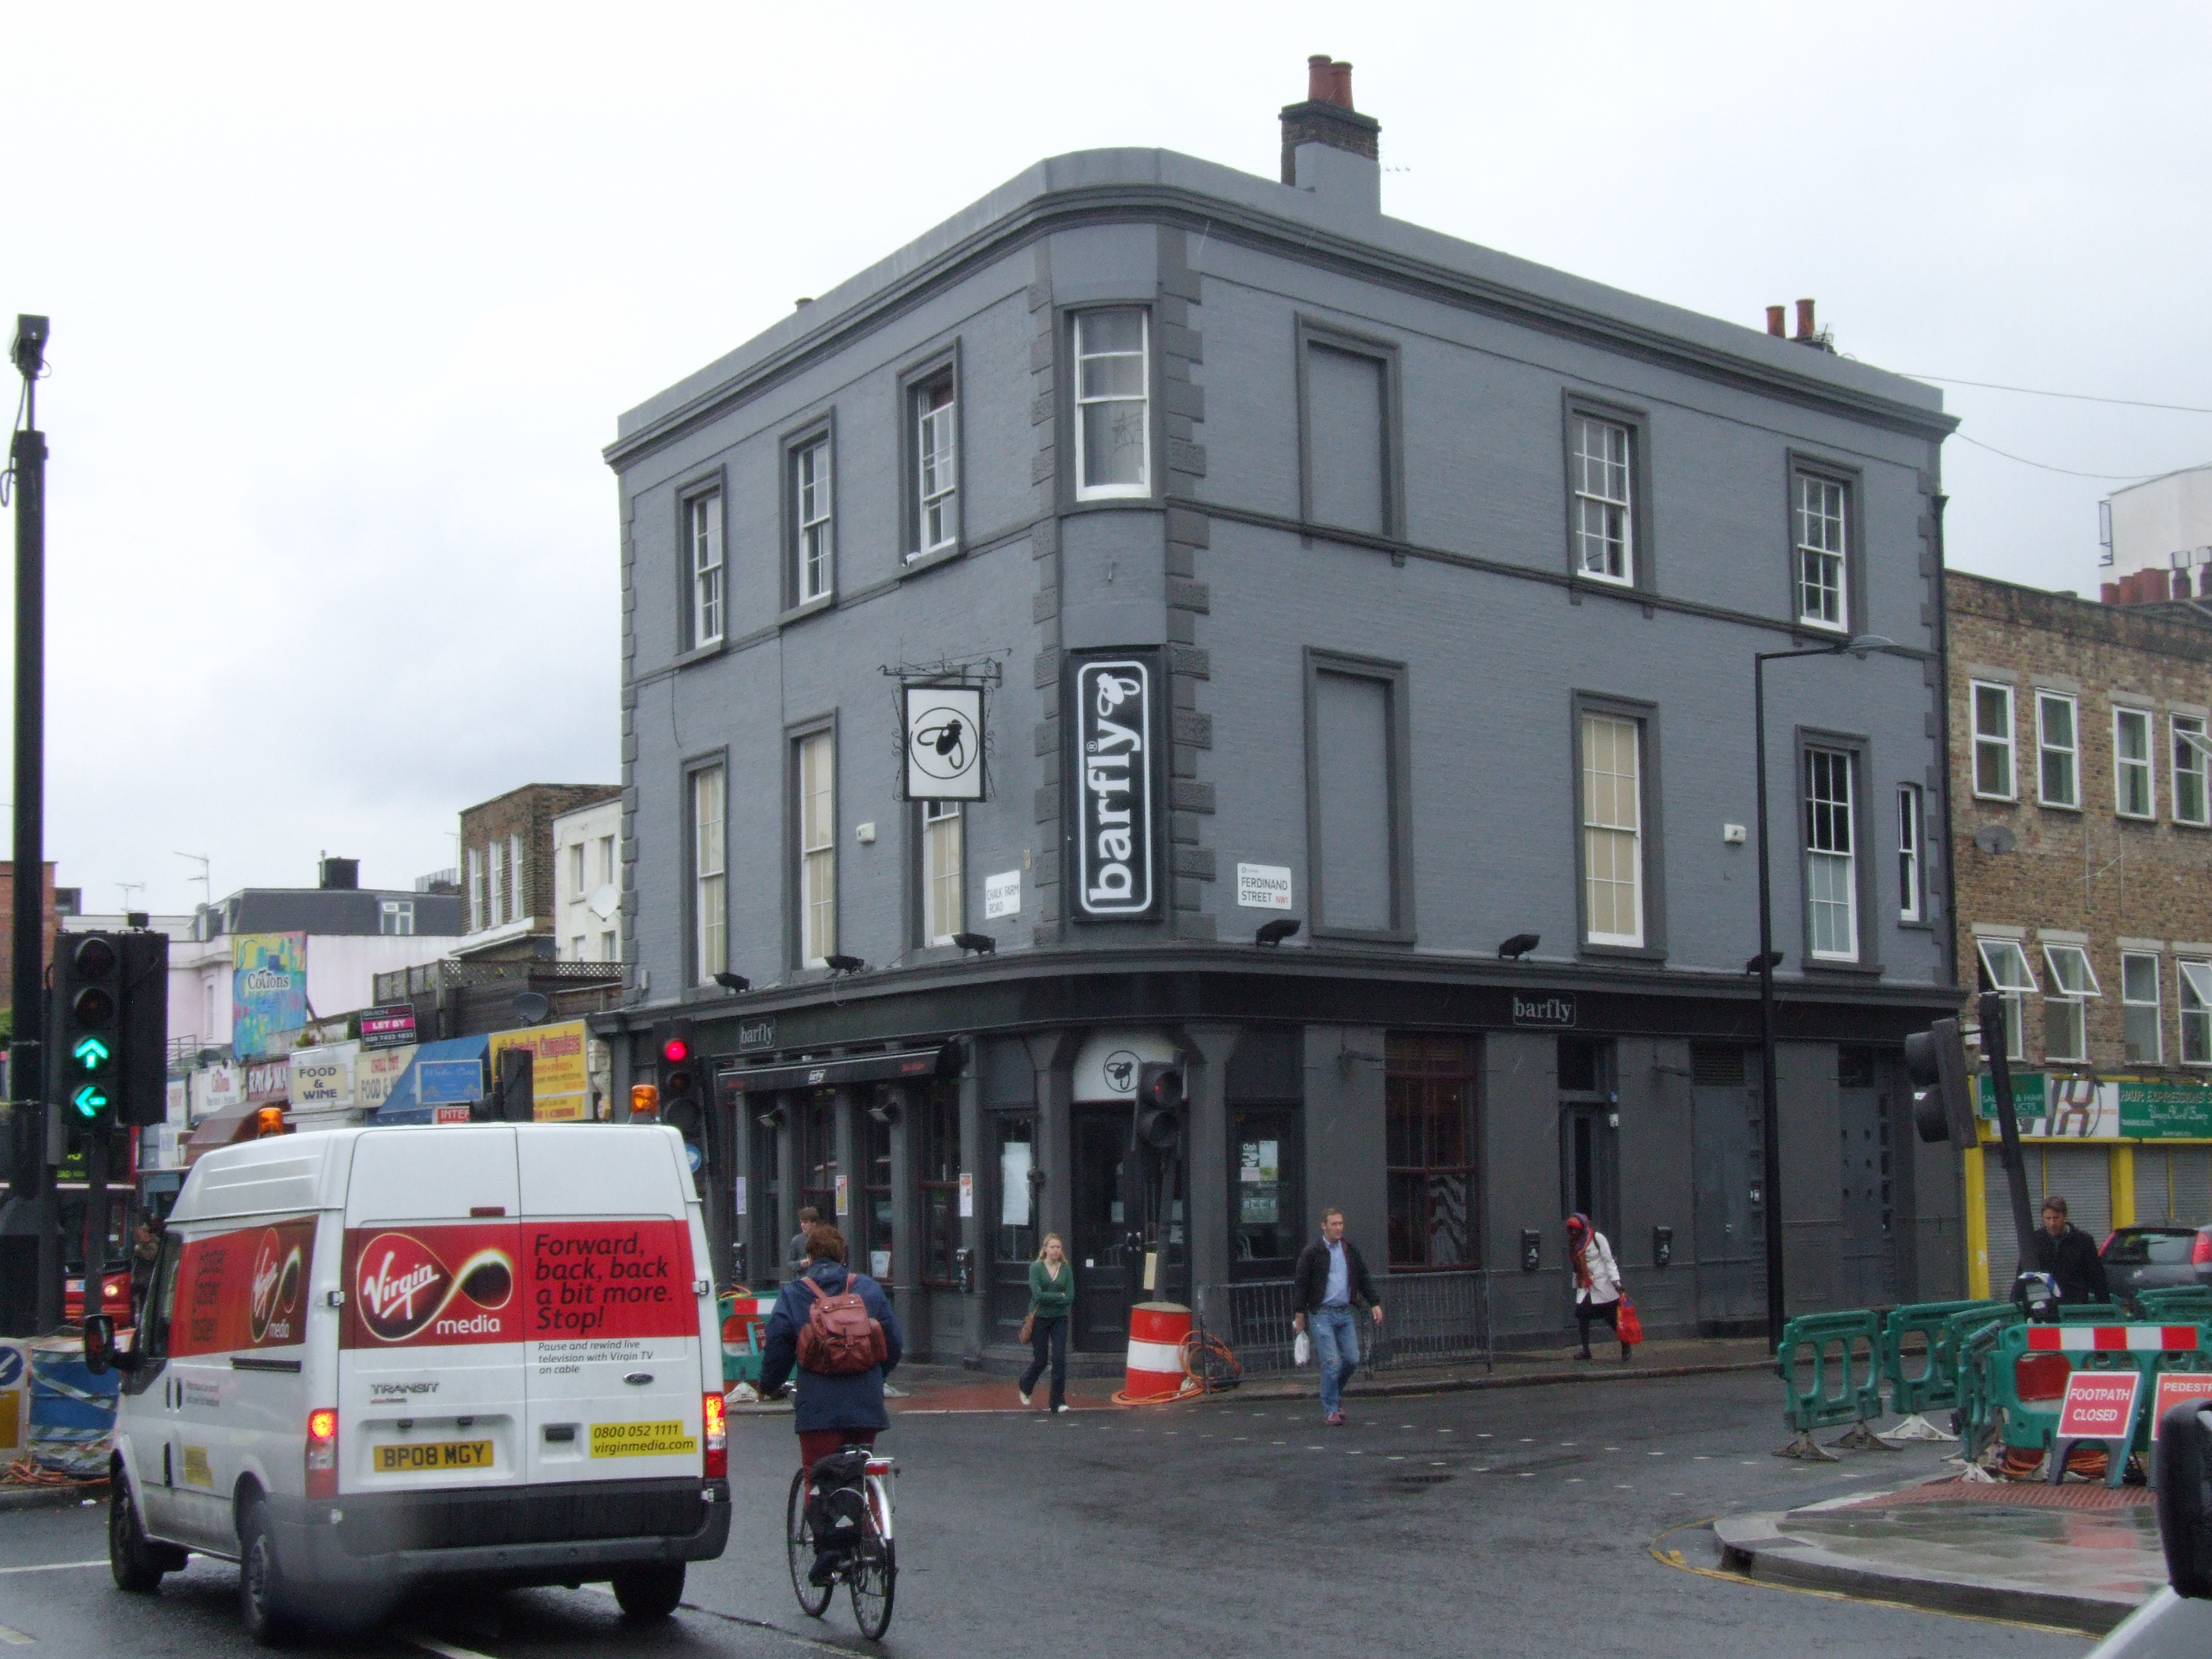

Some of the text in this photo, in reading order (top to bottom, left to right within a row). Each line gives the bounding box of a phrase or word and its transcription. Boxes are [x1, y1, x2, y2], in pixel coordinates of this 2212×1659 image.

[1241, 877, 1287, 890] FERDINAND
[987, 883, 1019, 900] CHALK FARM
[1242, 891, 1288, 904] STREET NW1
[989, 901, 1003, 913] ROAD
[248, 968, 290, 989] Cottons
[1513, 997, 1571, 1022] barfly
[372, 1018, 405, 1029] LET BY
[740, 1023, 773, 1044] barfly
[299, 1066, 337, 1077] FOOD
[314, 1079, 324, 1088] &
[361, 1078, 381, 1100] FOOD
[303, 1088, 337, 1100] WINE
[534, 1232, 644, 1258] Forward,
[535, 1256, 668, 1282] back, back
[363, 1251, 440, 1320] Virgin
[537, 1282, 672, 1305] a bit more.
[270, 1318, 290, 1338] media
[436, 1315, 500, 1334] media
[537, 1306, 604, 1335] Stop!
[538, 1340, 640, 1351] Pause and rewind live
[539, 1351, 653, 1363] television with Virgin TV
[554, 1365, 580, 1374] cable
[371, 1382, 439, 1394] TRANSIT
[2069, 1388, 2130, 1400] FOOTPATH
[2072, 1409, 2118, 1421] CLOSED
[594, 1424, 679, 1439] 0800 052 1111
[594, 1439, 694, 1455] virginmedia.com
[384, 1444, 484, 1467] BP08 MGY
